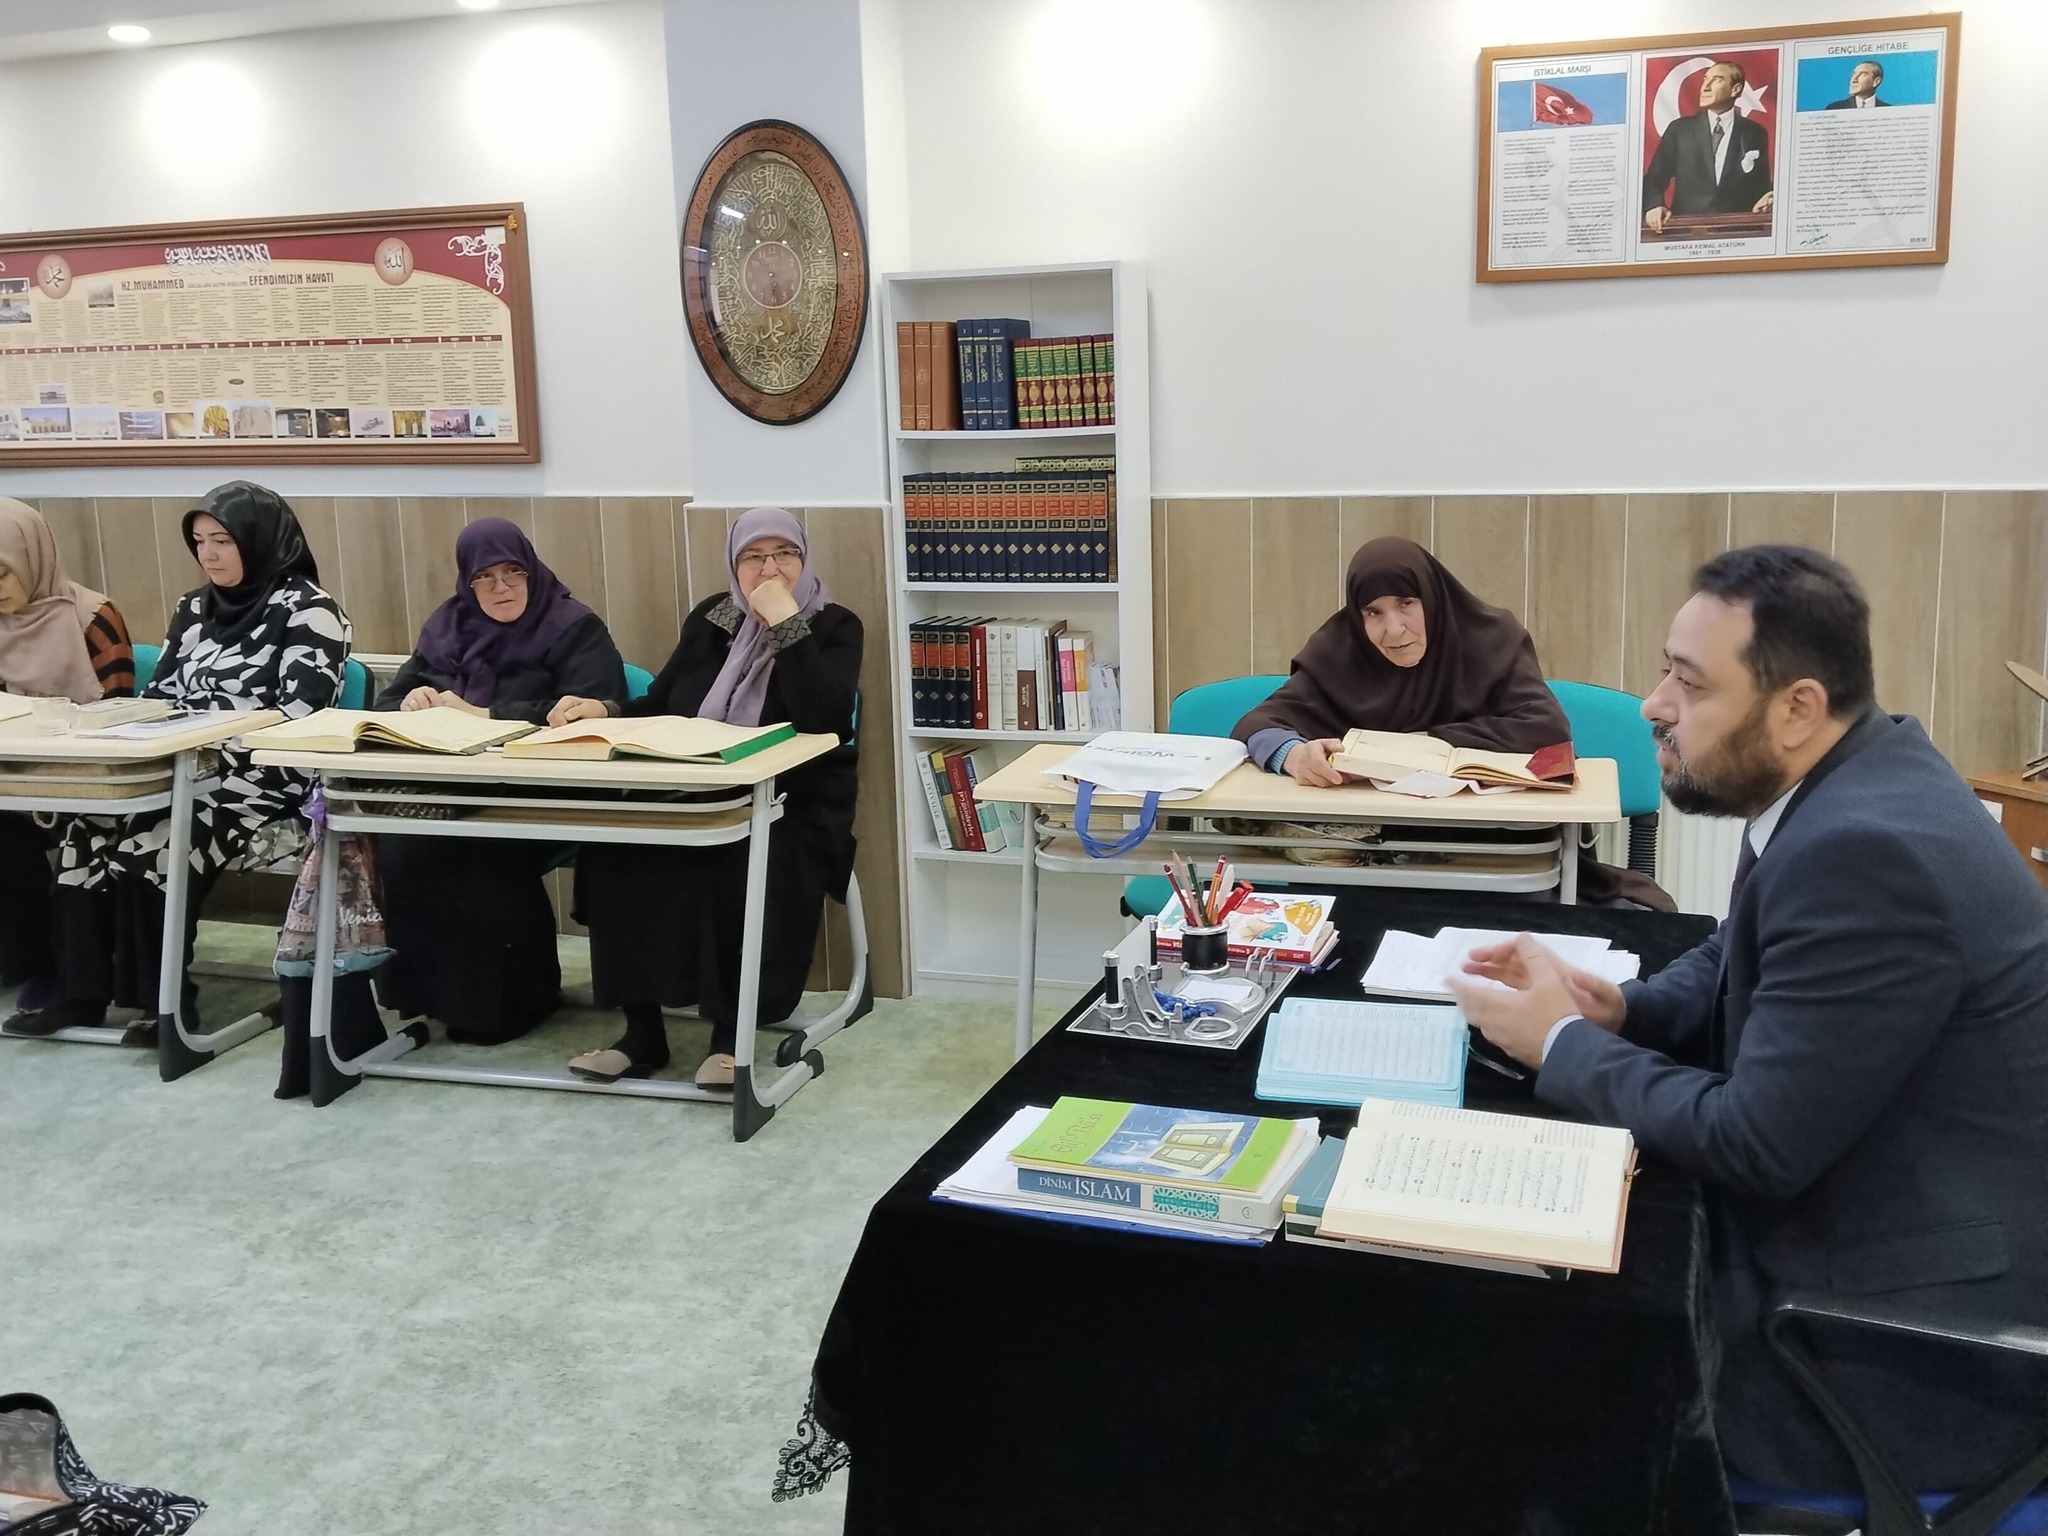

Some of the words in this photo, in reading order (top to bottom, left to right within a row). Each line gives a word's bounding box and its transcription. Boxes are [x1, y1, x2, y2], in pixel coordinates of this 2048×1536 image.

[1876, 41, 1908, 51] HİTABE
[1567, 65, 1591, 74] MARŞI
[306, 271, 334, 284] HAYATI
[1039, 1176, 1072, 1191] DİNİM
[1074, 1177, 1131, 1203] İSLAM
